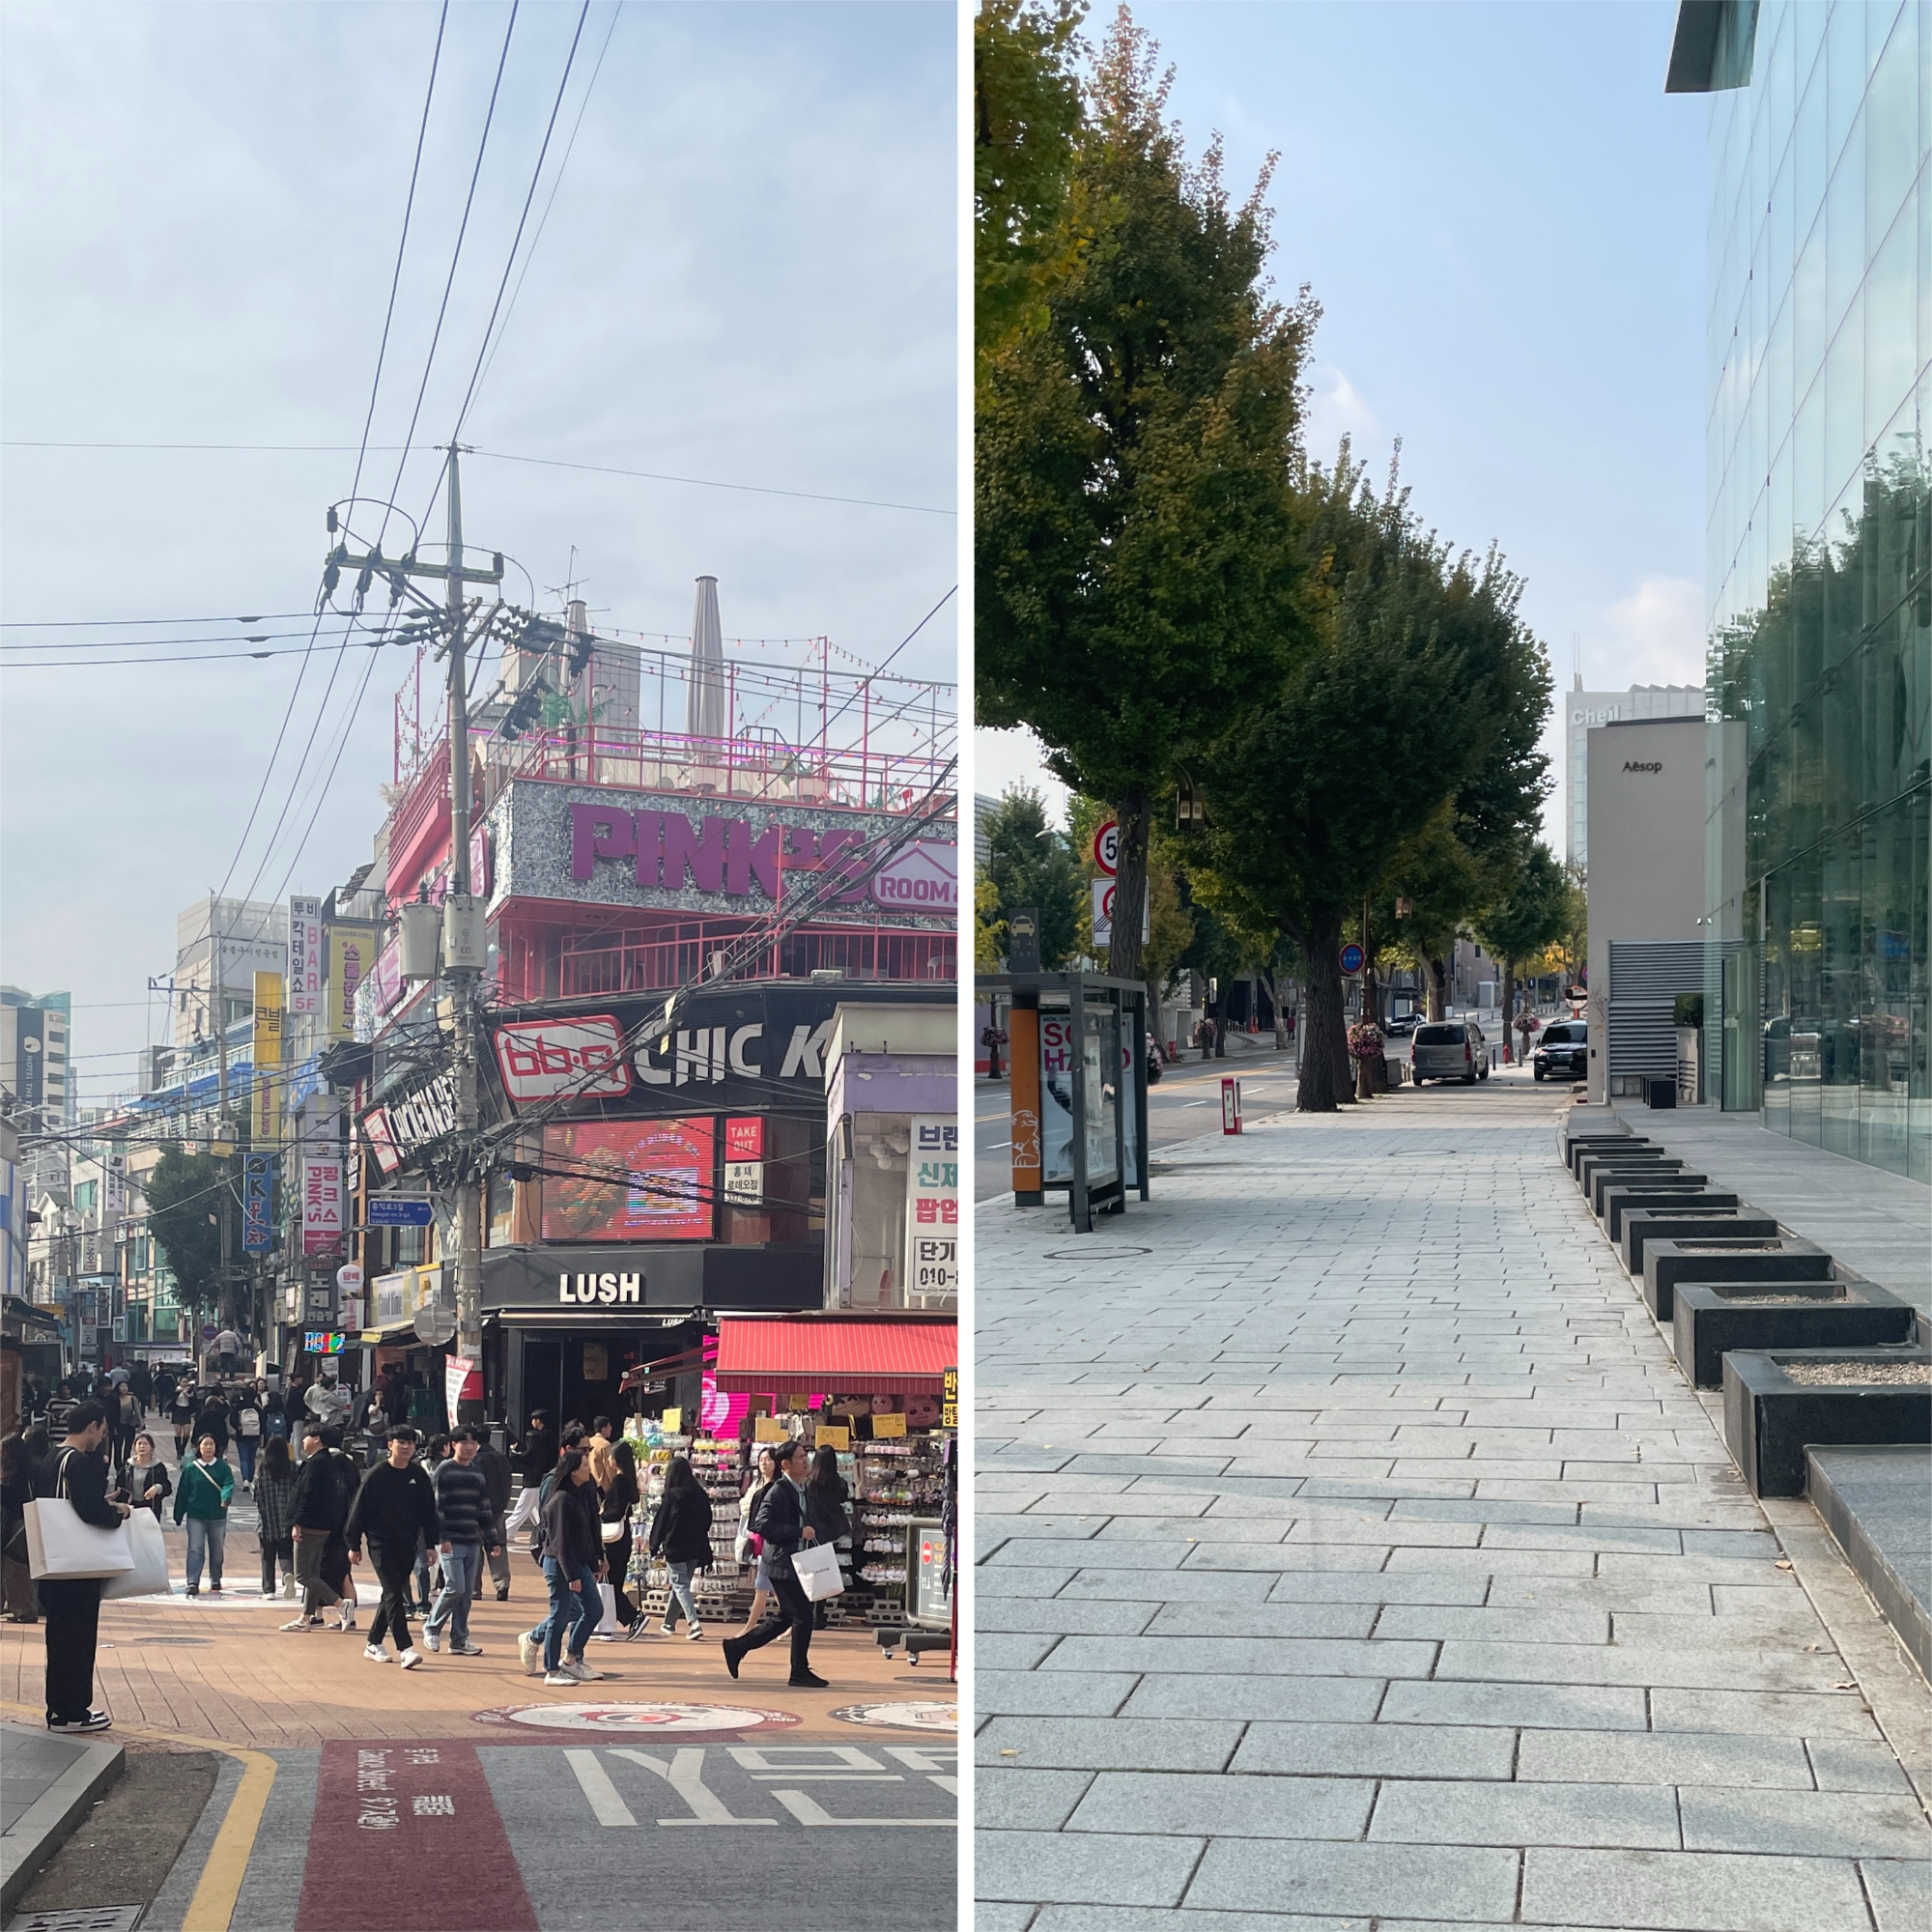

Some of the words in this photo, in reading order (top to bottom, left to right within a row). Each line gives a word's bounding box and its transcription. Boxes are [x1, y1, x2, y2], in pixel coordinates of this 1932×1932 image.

[1571, 705, 1620, 725] Cheil
[880, 876, 949, 901] ROOM
[307, 926, 318, 991] BAR
[295, 998, 316, 1010] 5F
[730, 1126, 757, 1138] TAKE
[733, 1140, 754, 1152] OUT
[307, 1166, 322, 1223] PINK'S
[323, 1166, 338, 1223] 핑크스
[920, 1241, 955, 1262] 단기
[342, 1271, 360, 1281] 담배
[920, 1266, 957, 1286] 010-
[559, 1271, 640, 1303] LUSH
